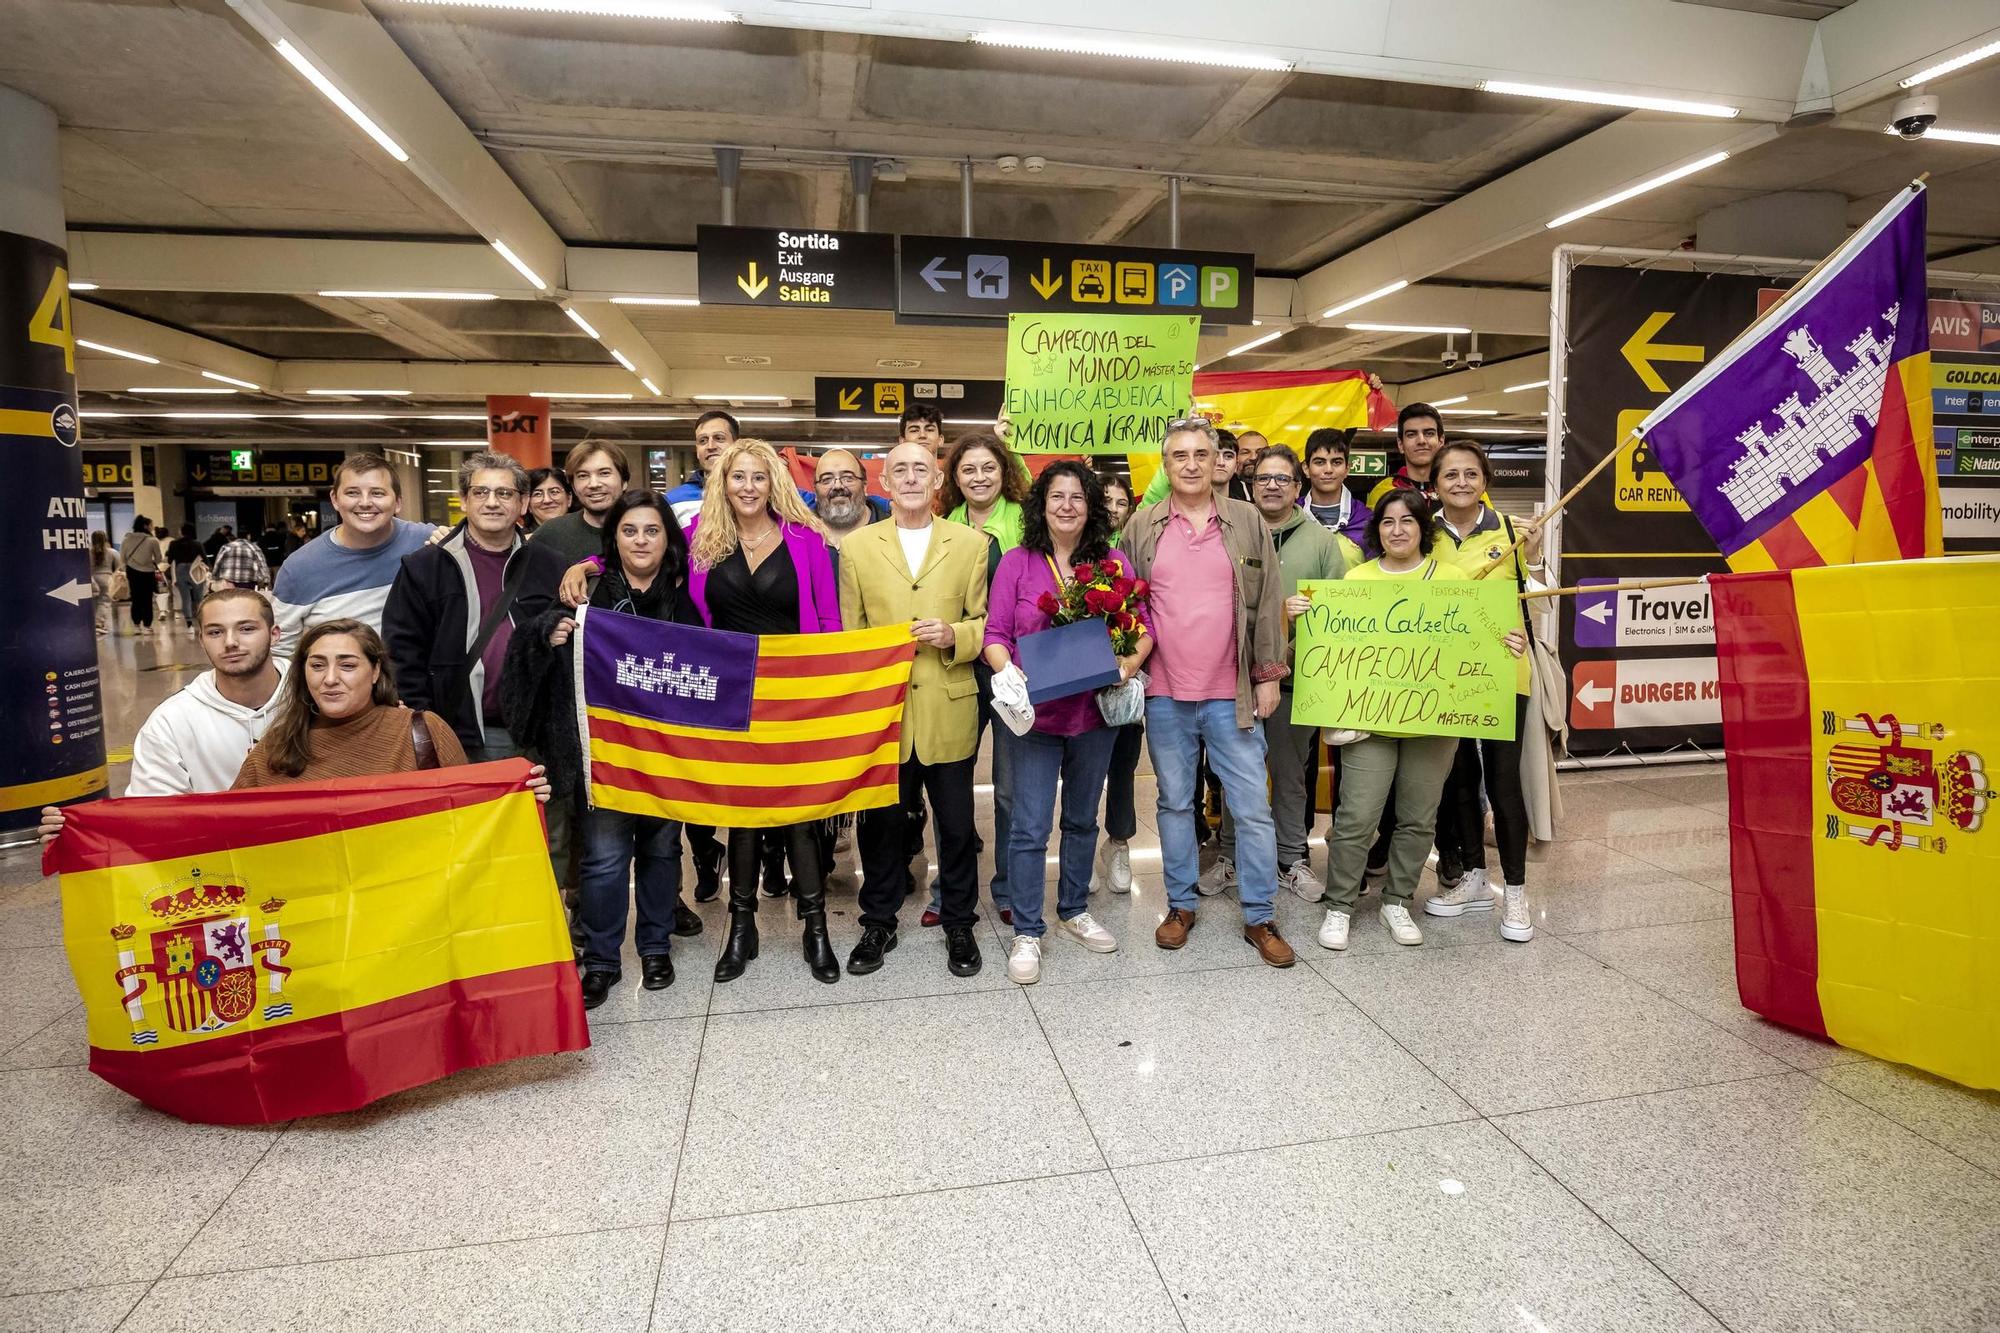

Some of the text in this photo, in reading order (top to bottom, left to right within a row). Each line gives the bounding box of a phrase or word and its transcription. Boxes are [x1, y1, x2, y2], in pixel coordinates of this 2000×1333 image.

[778, 232, 839, 250] Sortida
[778, 251, 803, 266] Exit
[1079, 262, 1104, 272] TAXI
[779, 268, 835, 286] Ausgang
[1210, 272, 1230, 302] P
[779, 285, 830, 302] Salida
[29, 266, 75, 374] 4
[1930, 316, 1970, 336] AVIS
[1021, 322, 1156, 355] CAMPEONA DEL
[1069, 354, 1192, 386] MUNDO MÁSTER 50
[1944, 395, 1967, 406] inter
[1014, 417, 1095, 449] MÓNICA
[1619, 487, 1643, 501] CAR
[47, 497, 86, 518] ATM
[1627, 593, 1709, 620] Travel
[1306, 598, 1471, 637] Mónica Calzetta
[1625, 627, 1666, 636] Electronics
[1675, 626, 1688, 634] SIM
[1301, 645, 1494, 682] CAMPEONA DEL
[1621, 682, 1696, 704] BURGER
[1336, 686, 1440, 726] MUNDO
[1437, 709, 1500, 726] MÁSTER 50
[258, 940, 288, 950] VLTRA
